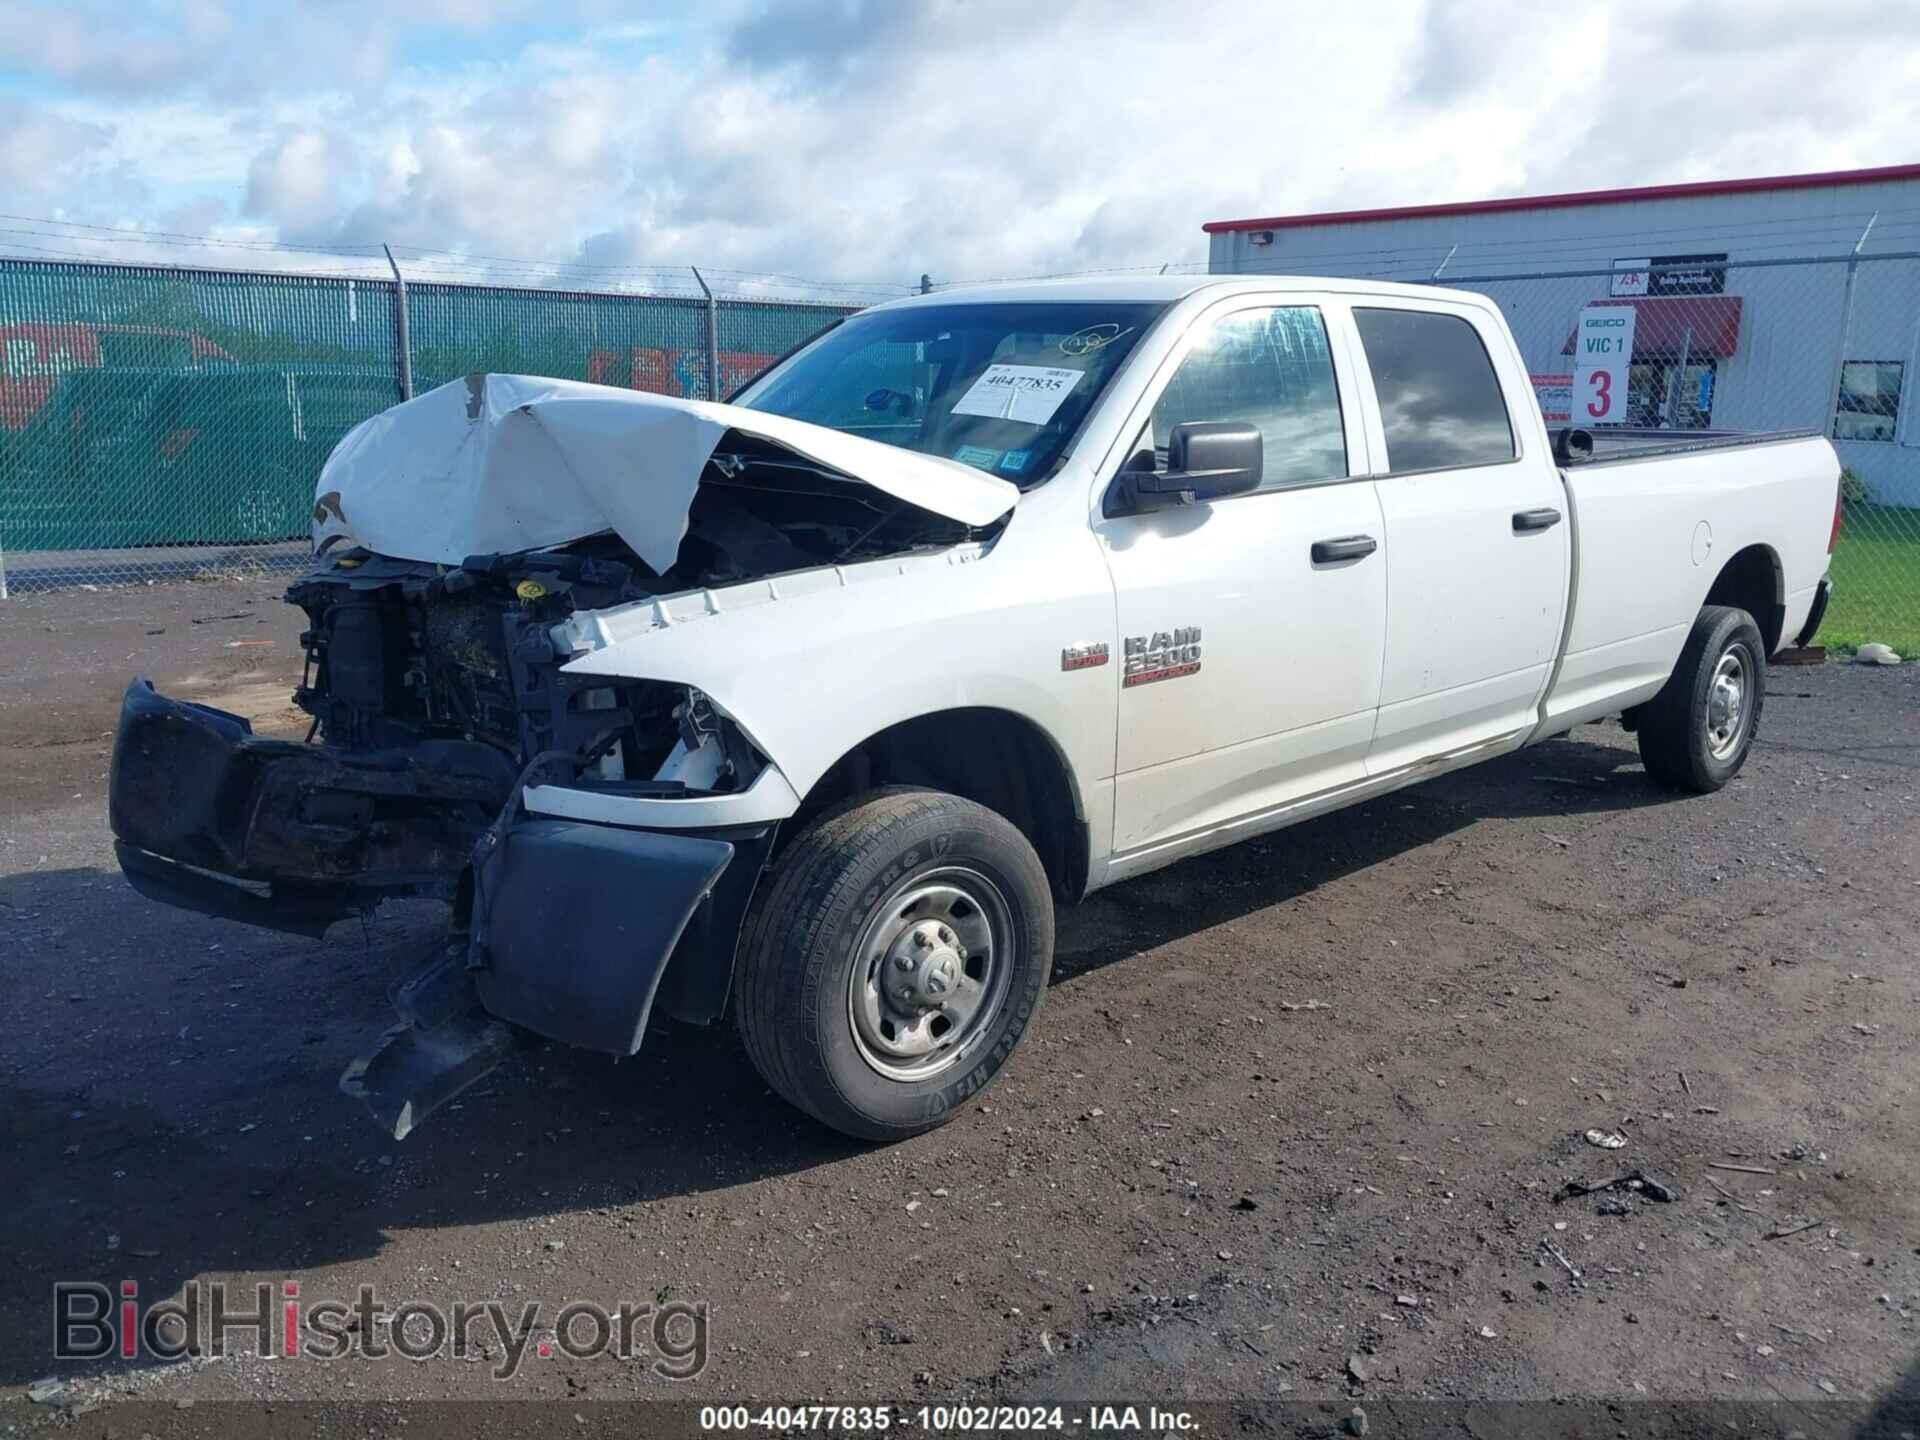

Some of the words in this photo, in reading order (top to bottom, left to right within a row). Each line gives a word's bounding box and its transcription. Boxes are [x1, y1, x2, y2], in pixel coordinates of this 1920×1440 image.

[1585, 318, 1626, 328] GEICO
[1585, 337, 1610, 353] VIC
[1616, 337, 1624, 353] 1
[986, 374, 1063, 391] 40477835
[1586, 370, 1612, 418] 3
[1124, 627, 1201, 655] RAM
[1124, 645, 1201, 675] 2500
